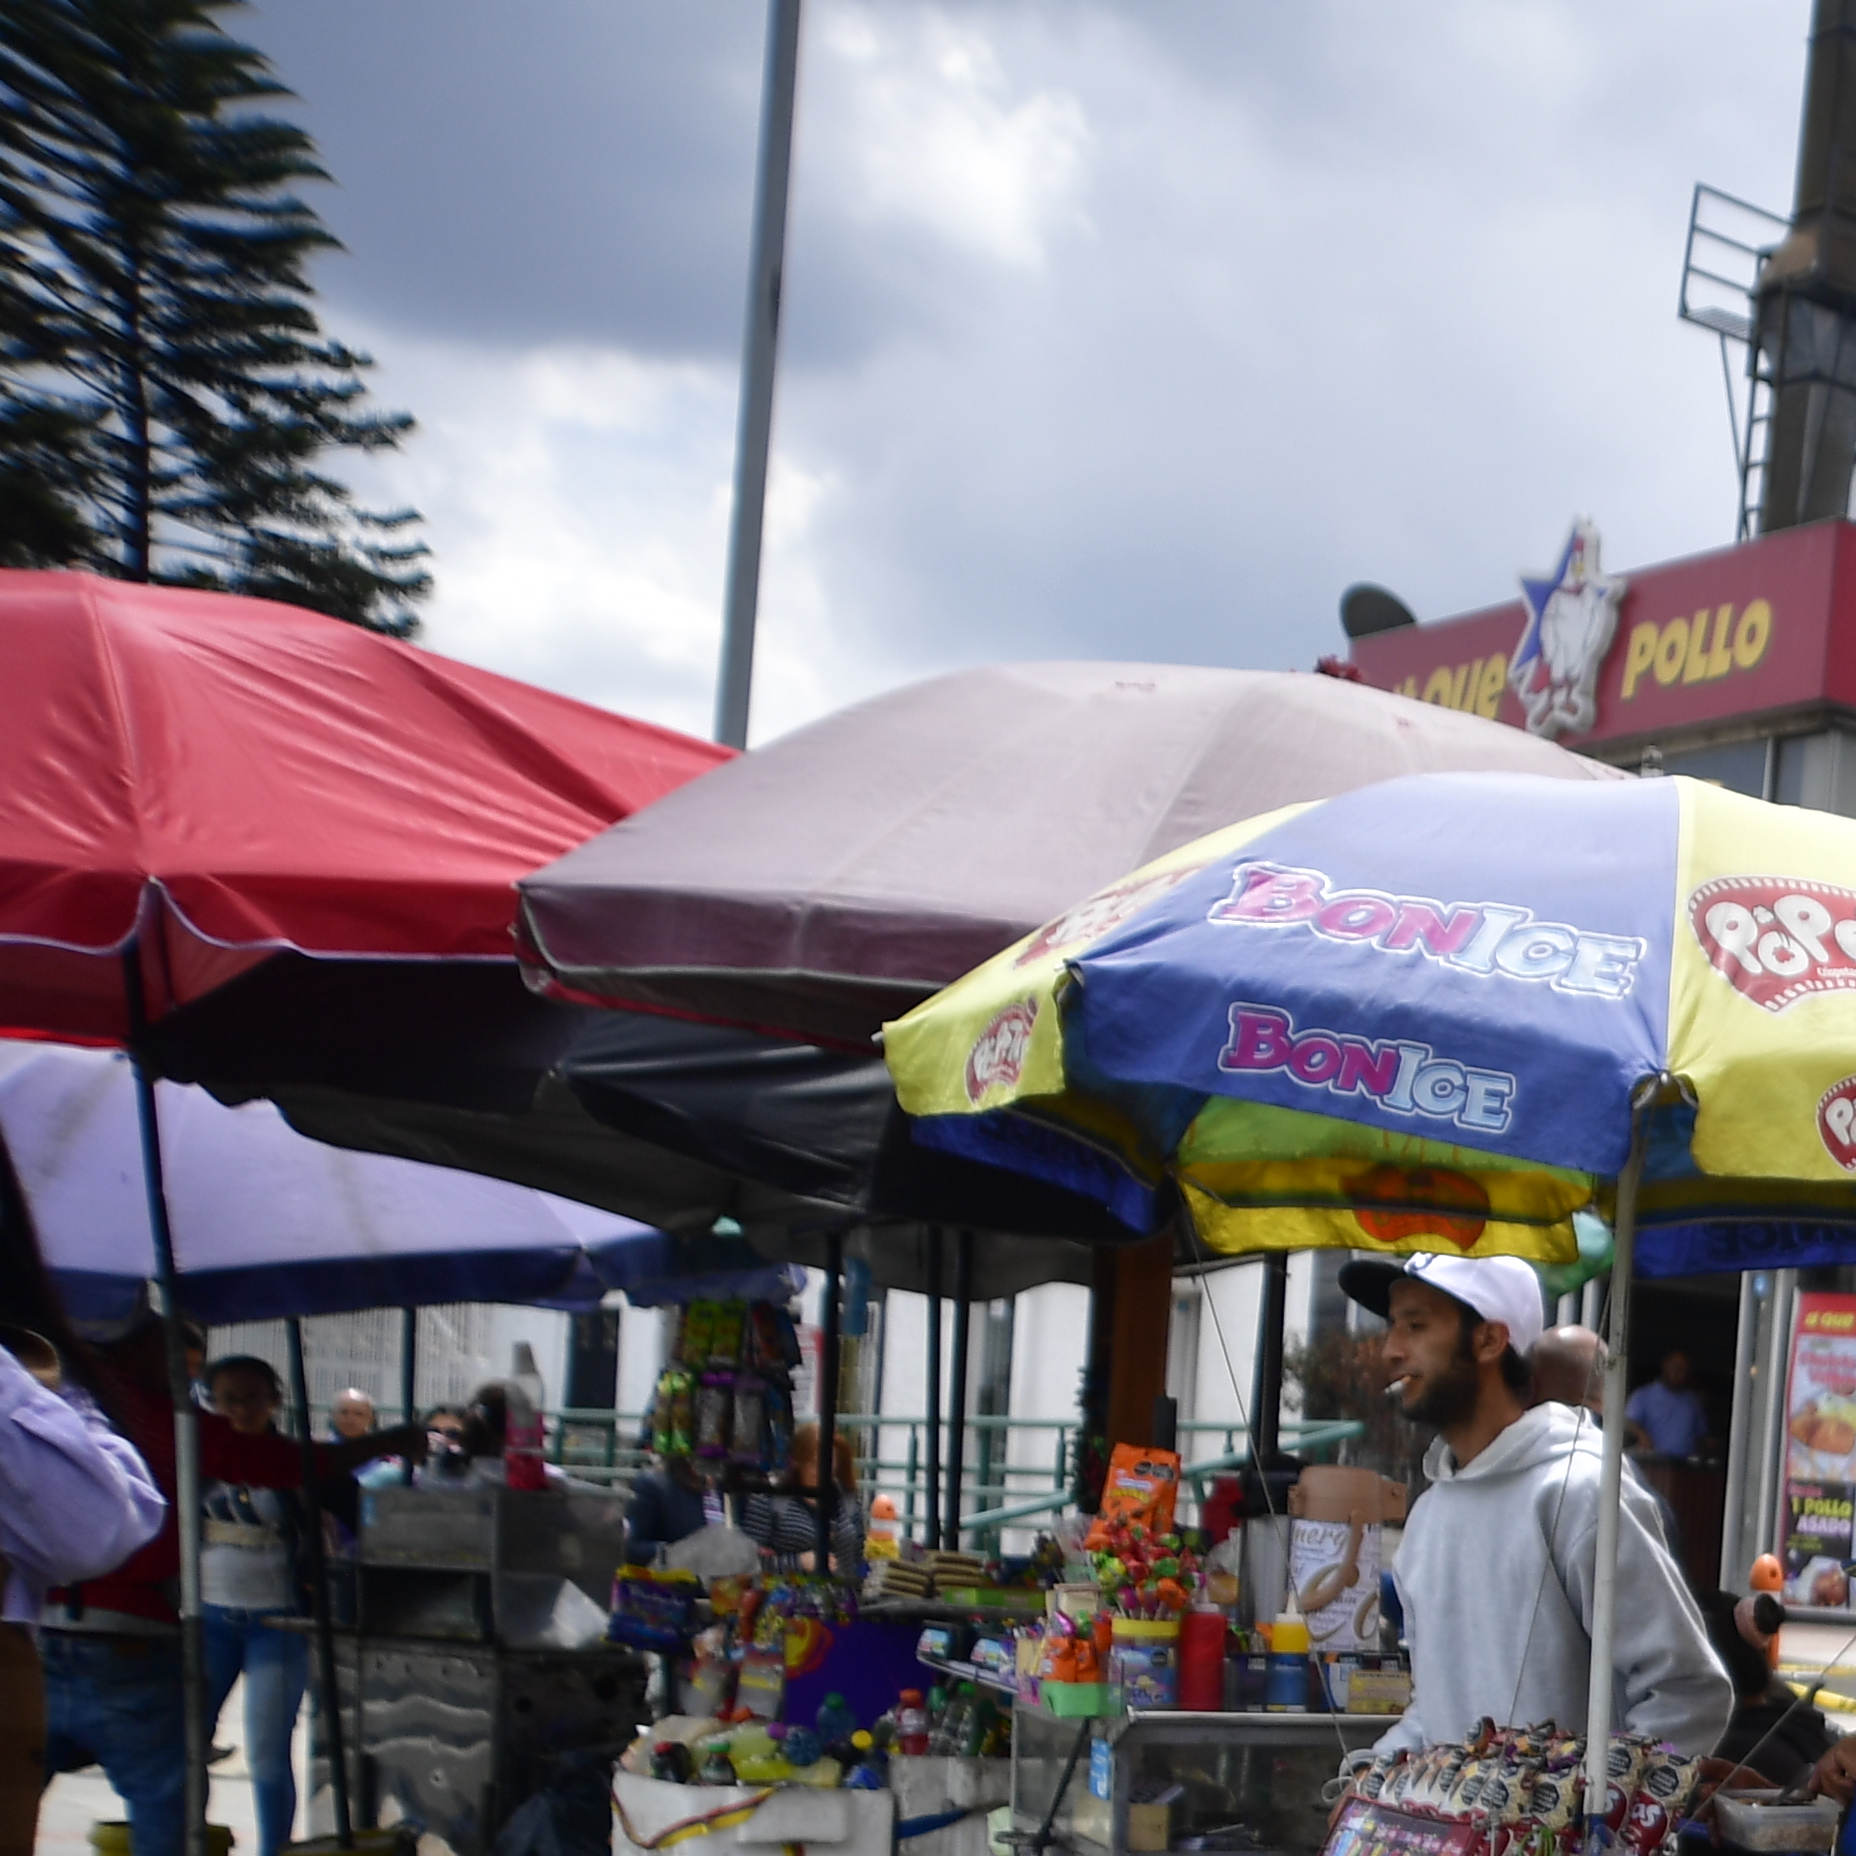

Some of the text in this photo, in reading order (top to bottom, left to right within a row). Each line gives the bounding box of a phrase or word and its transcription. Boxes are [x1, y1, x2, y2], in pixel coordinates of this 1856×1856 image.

[1621, 599, 1771, 699] POLLO
[1804, 1497, 1852, 1519] POLLO
[1796, 1515, 1852, 1537] ASADO
